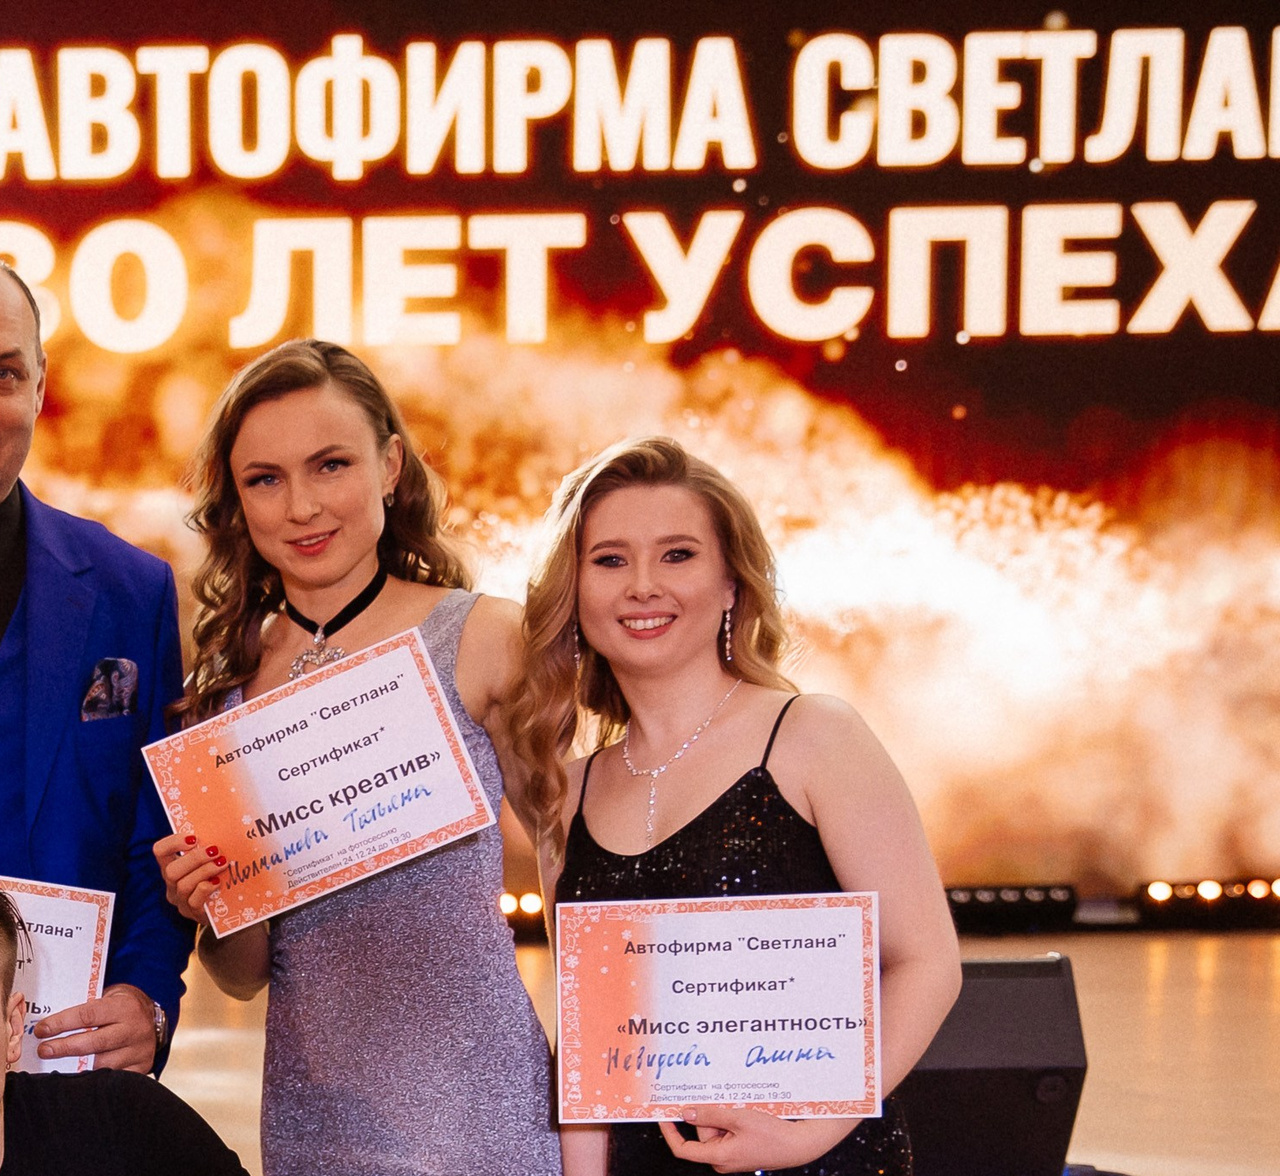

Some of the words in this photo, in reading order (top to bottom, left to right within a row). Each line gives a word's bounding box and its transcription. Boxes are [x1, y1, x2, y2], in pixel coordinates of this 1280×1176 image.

[790, 25, 1280, 170] СВЕТЛА
[228, 212, 588, 350] ЛЕТ
[622, 199, 1280, 345] УСПЕХ
[214, 719, 309, 769] Автофирма
[310, 673, 404, 721] "Светлана"
[246, 798, 325, 840] «Мисс
[328, 750, 441, 807] креатив»
[336, 848, 348, 856] на
[348, 827, 398, 853] фотосессию
[287, 862, 343, 889] Действителен
[343, 846, 377, 866] 24.12.24
[378, 842, 389, 851] до
[389, 831, 412, 845] 19:30
[16, 920, 83, 939] етлана"
[624, 939, 733, 957] Автофирма
[738, 934, 846, 951] "Светлана"
[617, 1017, 690, 1036] «Мисс
[696, 1015, 868, 1033] элегантность»
[650, 1093, 713, 1103] Действителен
[713, 1092, 753, 1101] 24.12.24
[753, 1093, 766, 1102] до
[767, 1091, 792, 1100] 19:30
[724, 1081, 781, 1091] фотосессию
